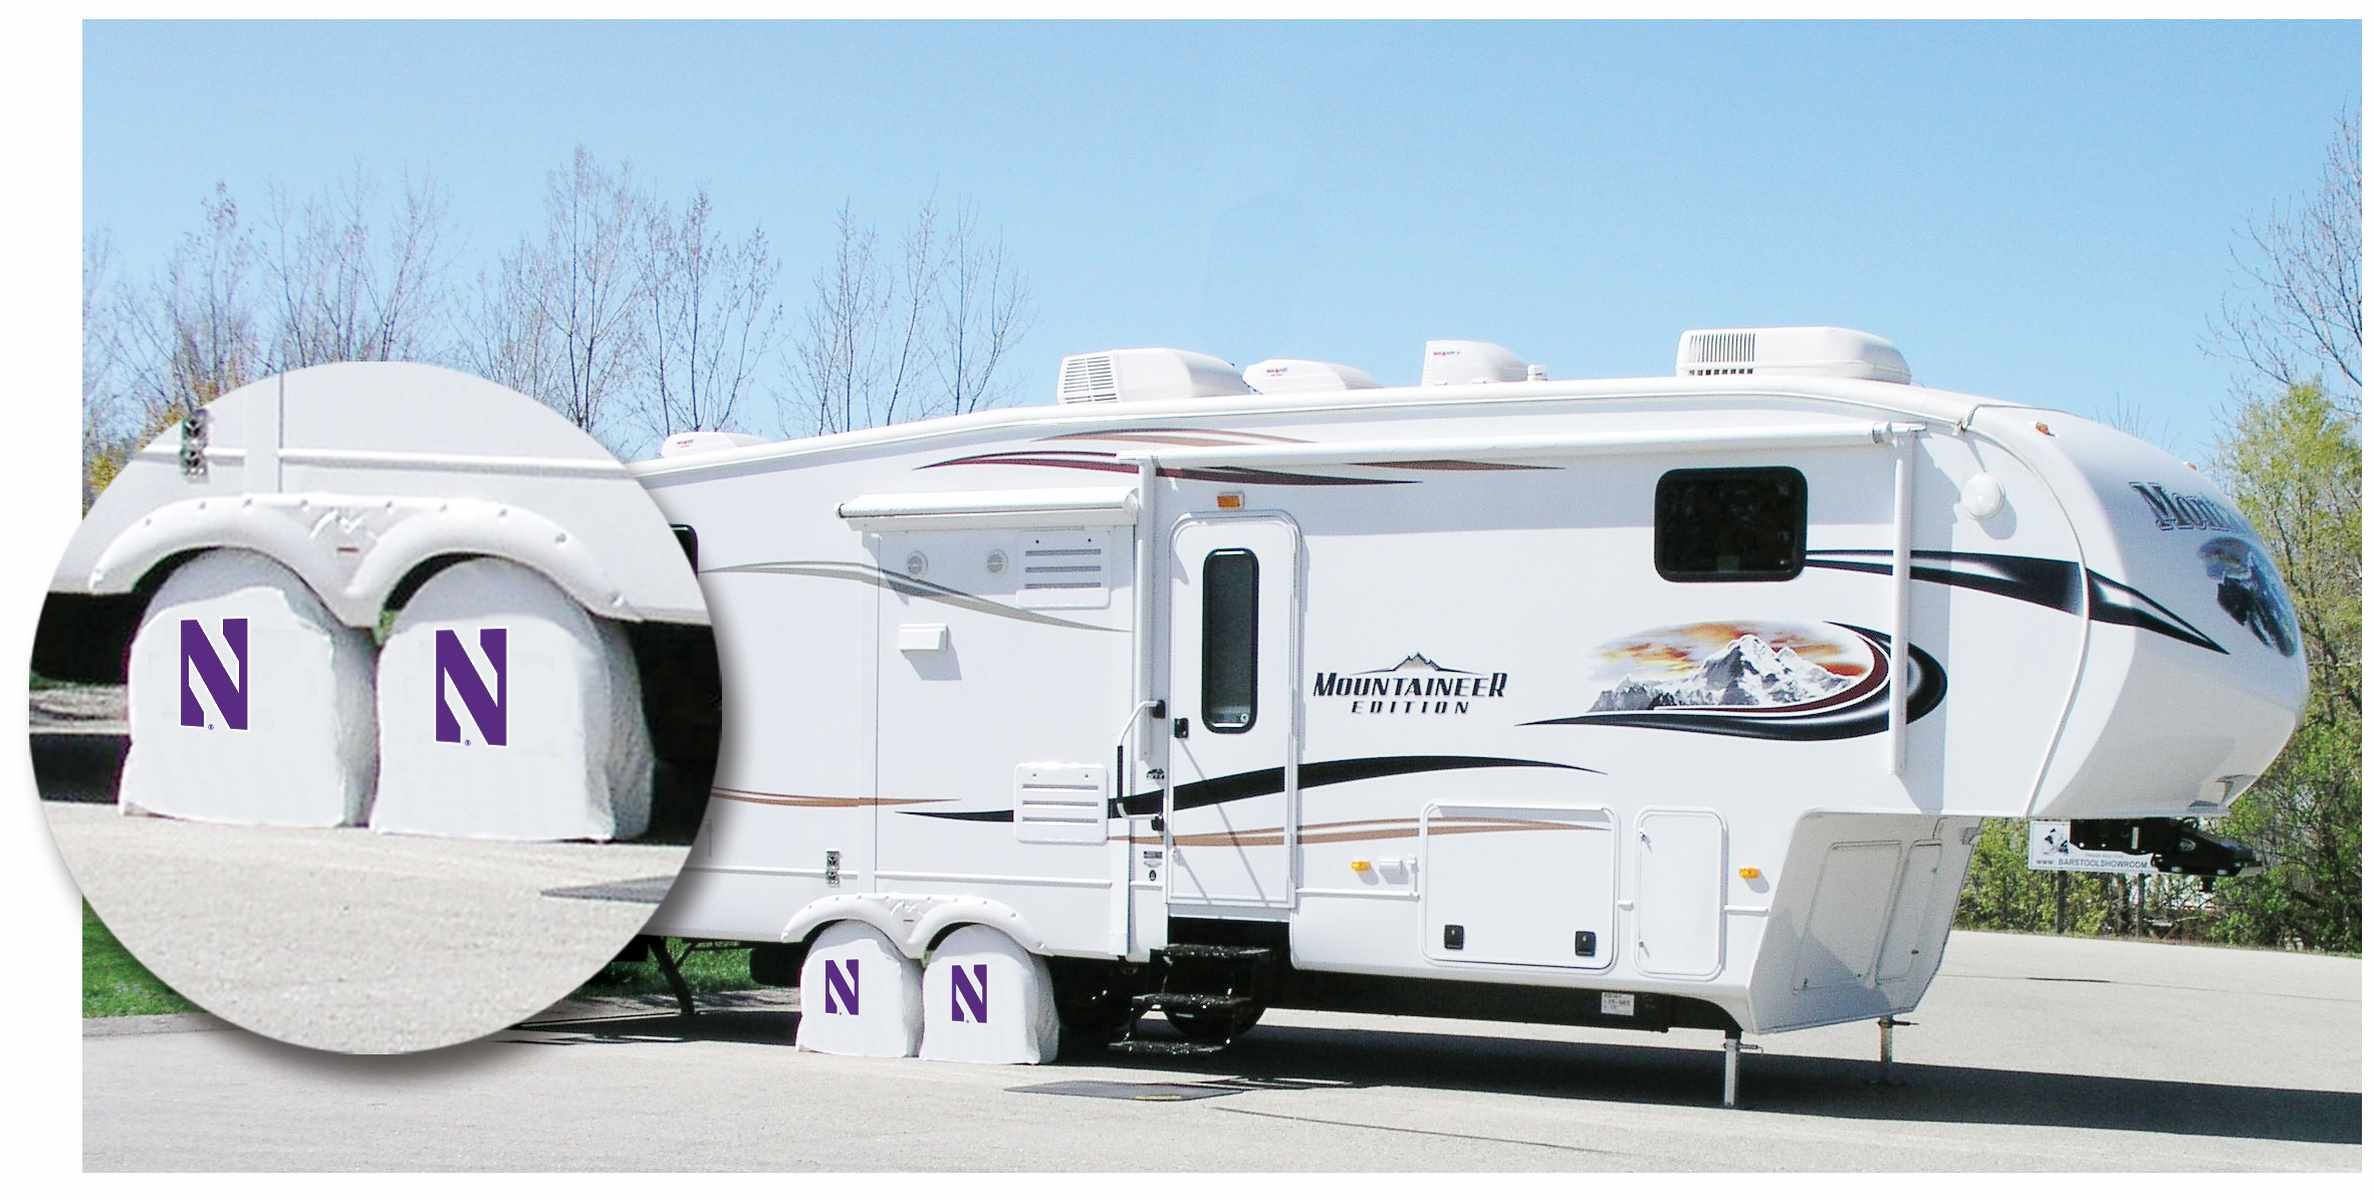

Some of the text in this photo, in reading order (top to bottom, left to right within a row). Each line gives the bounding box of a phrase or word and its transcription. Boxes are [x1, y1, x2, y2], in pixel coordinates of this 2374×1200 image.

[180, 618, 248, 730] N
[436, 628, 507, 746] N
[1313, 672, 1508, 697] MOUNTAINEER
[1351, 700, 1470, 714] EDITION
[825, 959, 859, 1016] N
[952, 964, 987, 1023] N
